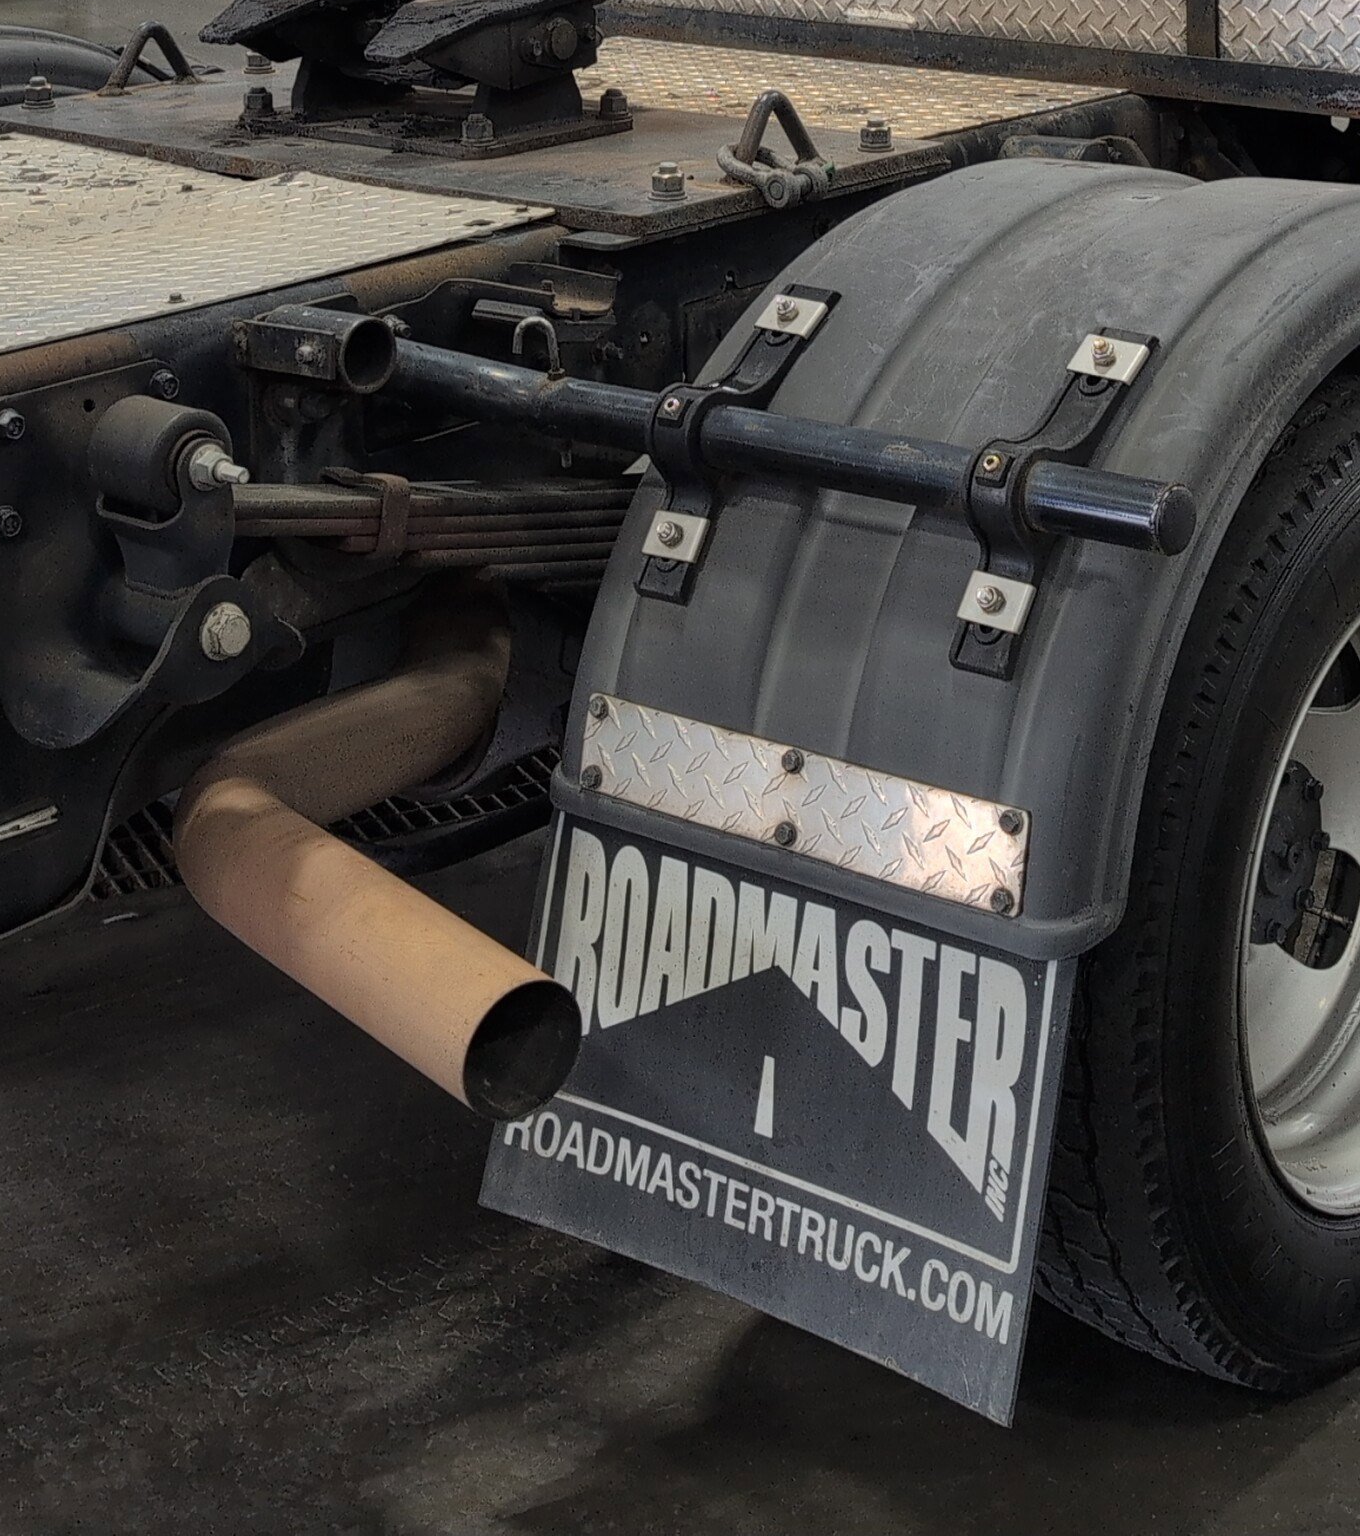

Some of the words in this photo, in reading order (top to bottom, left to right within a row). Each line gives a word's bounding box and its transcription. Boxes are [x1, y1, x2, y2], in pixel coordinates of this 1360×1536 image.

[554, 826, 1027, 1195] ROADMASTER
[503, 1112, 1015, 1345] ROADMASTERTRUCK.COM
[984, 1158, 1010, 1223] INC
